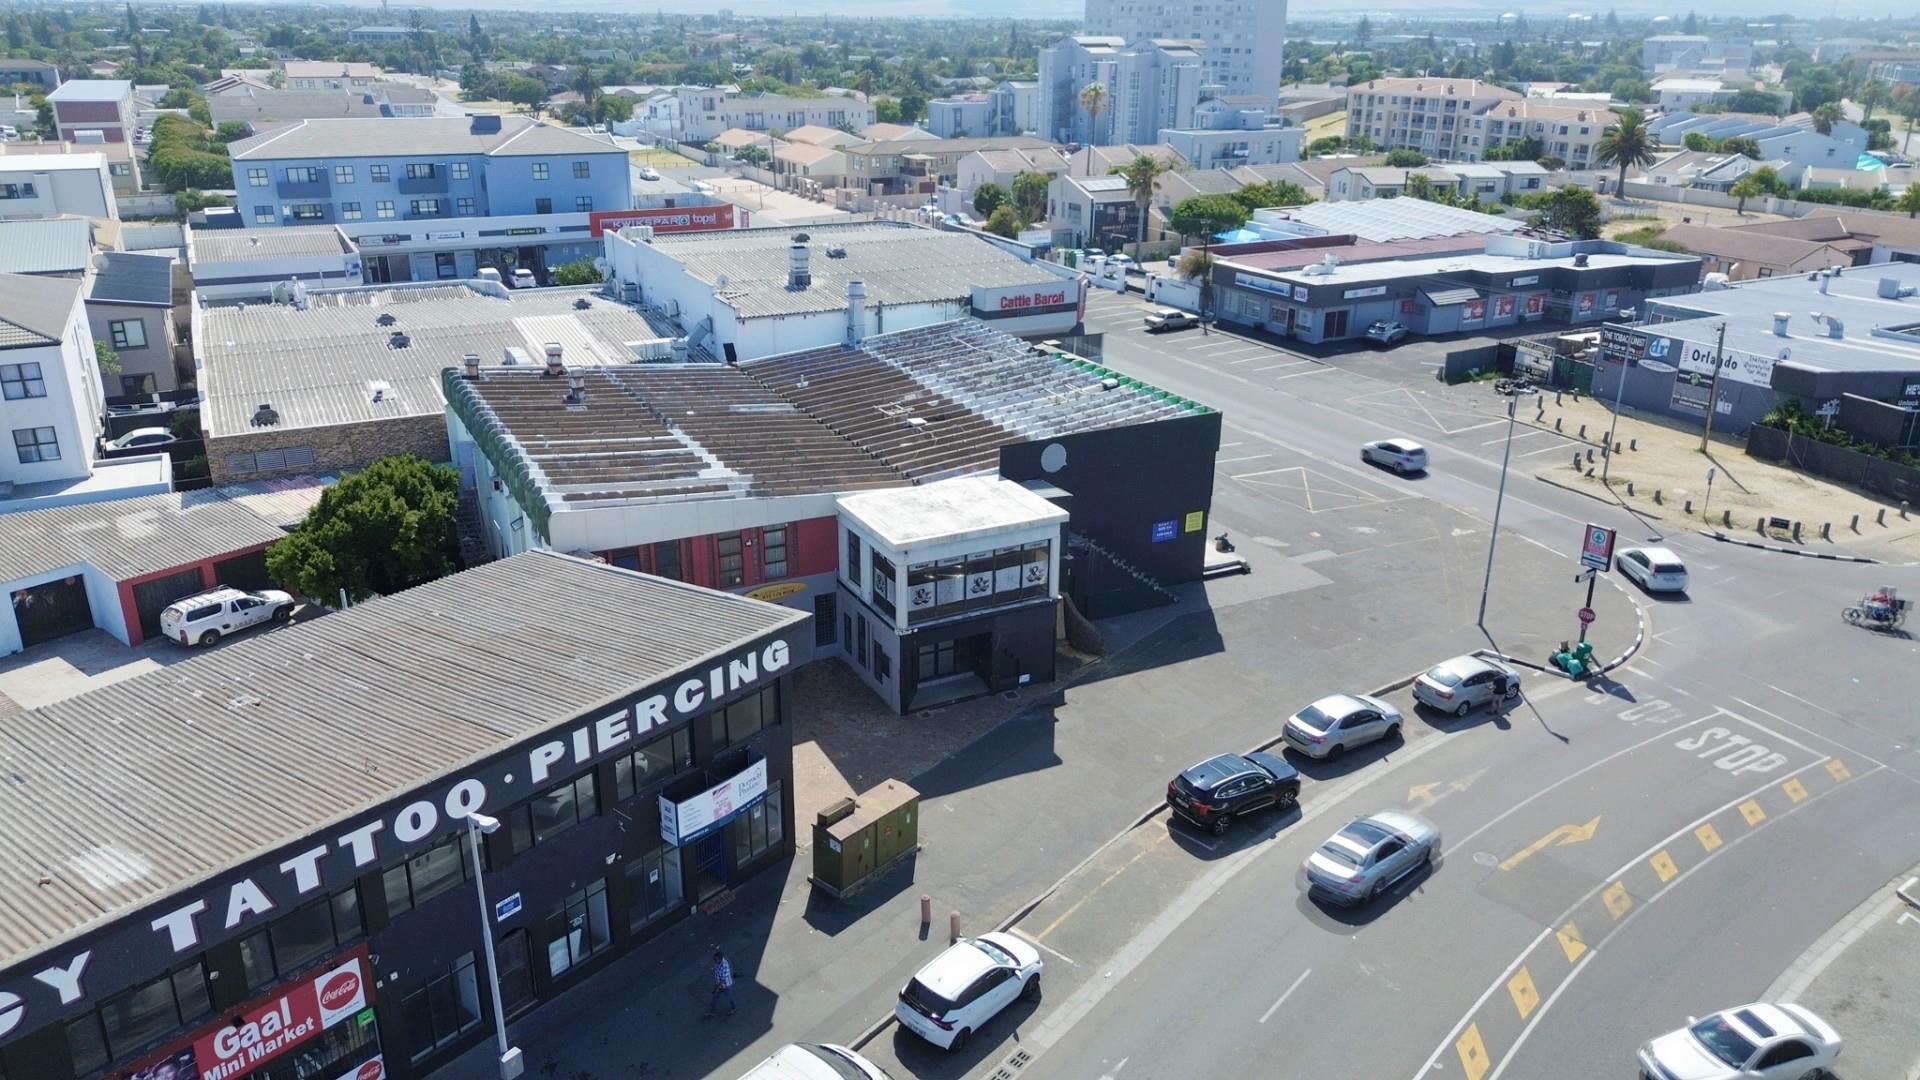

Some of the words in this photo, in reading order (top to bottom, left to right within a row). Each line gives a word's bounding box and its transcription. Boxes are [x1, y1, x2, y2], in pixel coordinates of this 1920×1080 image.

[613, 217, 680, 228] KWIKSPAR
[1000, 294, 1031, 309] Cattle
[1034, 291, 1065, 305] Baron
[1580, 610, 1595, 620] STOP
[1674, 727, 1788, 776] STOP
[151, 779, 486, 952] TATTOO
[529, 639, 790, 784] PIERCING
[203, 1052, 246, 1080] Mini
[247, 1016, 314, 1063] Market
[213, 996, 292, 1060] Gaal
